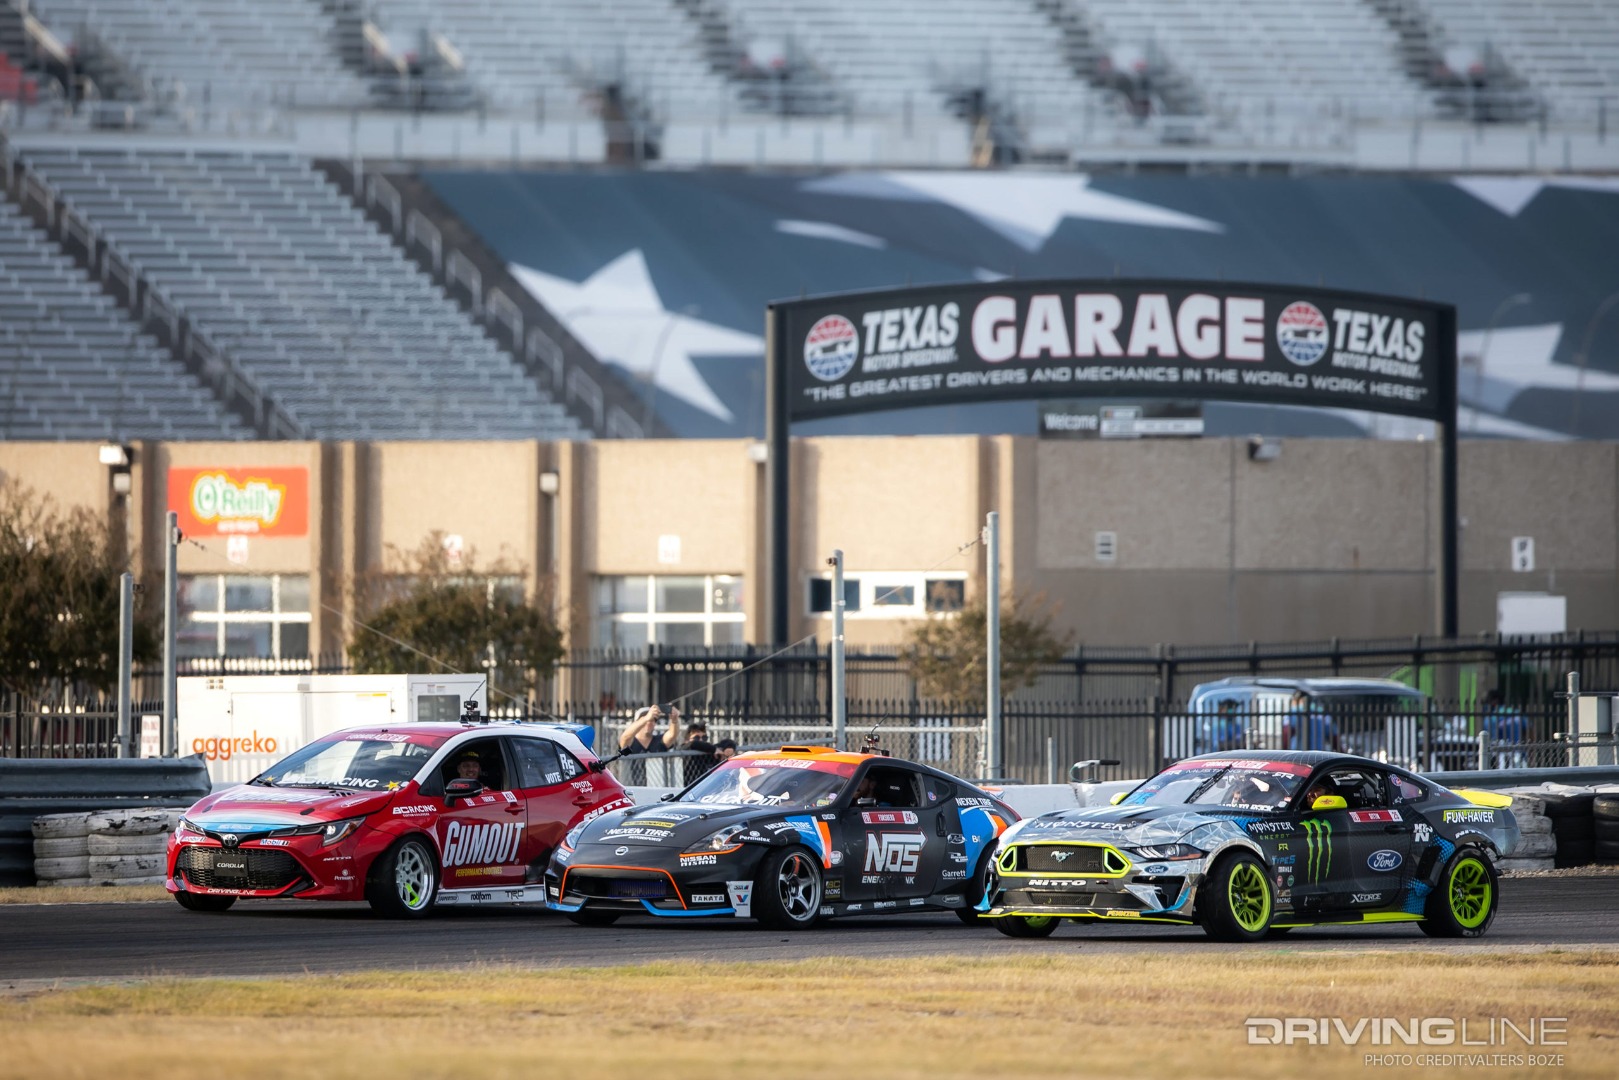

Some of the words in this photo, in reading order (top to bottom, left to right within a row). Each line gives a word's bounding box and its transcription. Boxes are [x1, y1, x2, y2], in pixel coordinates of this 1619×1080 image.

[862, 301, 960, 355] TEXAS
[971, 294, 1265, 362] GARAGE
[1332, 308, 1425, 362] TEXAS
[849, 374, 943, 397] GREATEST
[946, 368, 1027, 387] DRIVERS
[1031, 366, 1071, 382] AND
[1074, 366, 1179, 382] MECHANICS
[1183, 367, 1201, 382] IN
[1205, 368, 1238, 383] THE
[1241, 369, 1307, 388] WORLD
[1311, 375, 1366, 394] WORK
[1044, 413, 1098, 430] Welcome
[195, 476, 280, 523] O'Reilly
[192, 730, 277, 761] aggreko
[545, 771, 562, 784] VOTE
[570, 780, 593, 789] TOYOTA
[955, 797, 978, 806] NEXEN
[409, 804, 437, 813] RACING
[1446, 811, 1494, 824] FUN-HAVER
[606, 828, 644, 836] NEXEN
[644, 828, 670, 837] TIRE
[765, 821, 793, 831] NEXEN
[794, 821, 813, 830] TIRE
[442, 820, 525, 868] GUMOUT
[739, 834, 771, 843] Permatex
[864, 831, 927, 873] NOS
[1373, 852, 1396, 868] Ford
[941, 869, 966, 877] Garrett
[1028, 879, 1087, 887] NITTO
[505, 889, 524, 900] TRD
[1107, 910, 1141, 918] PENNZOIL
